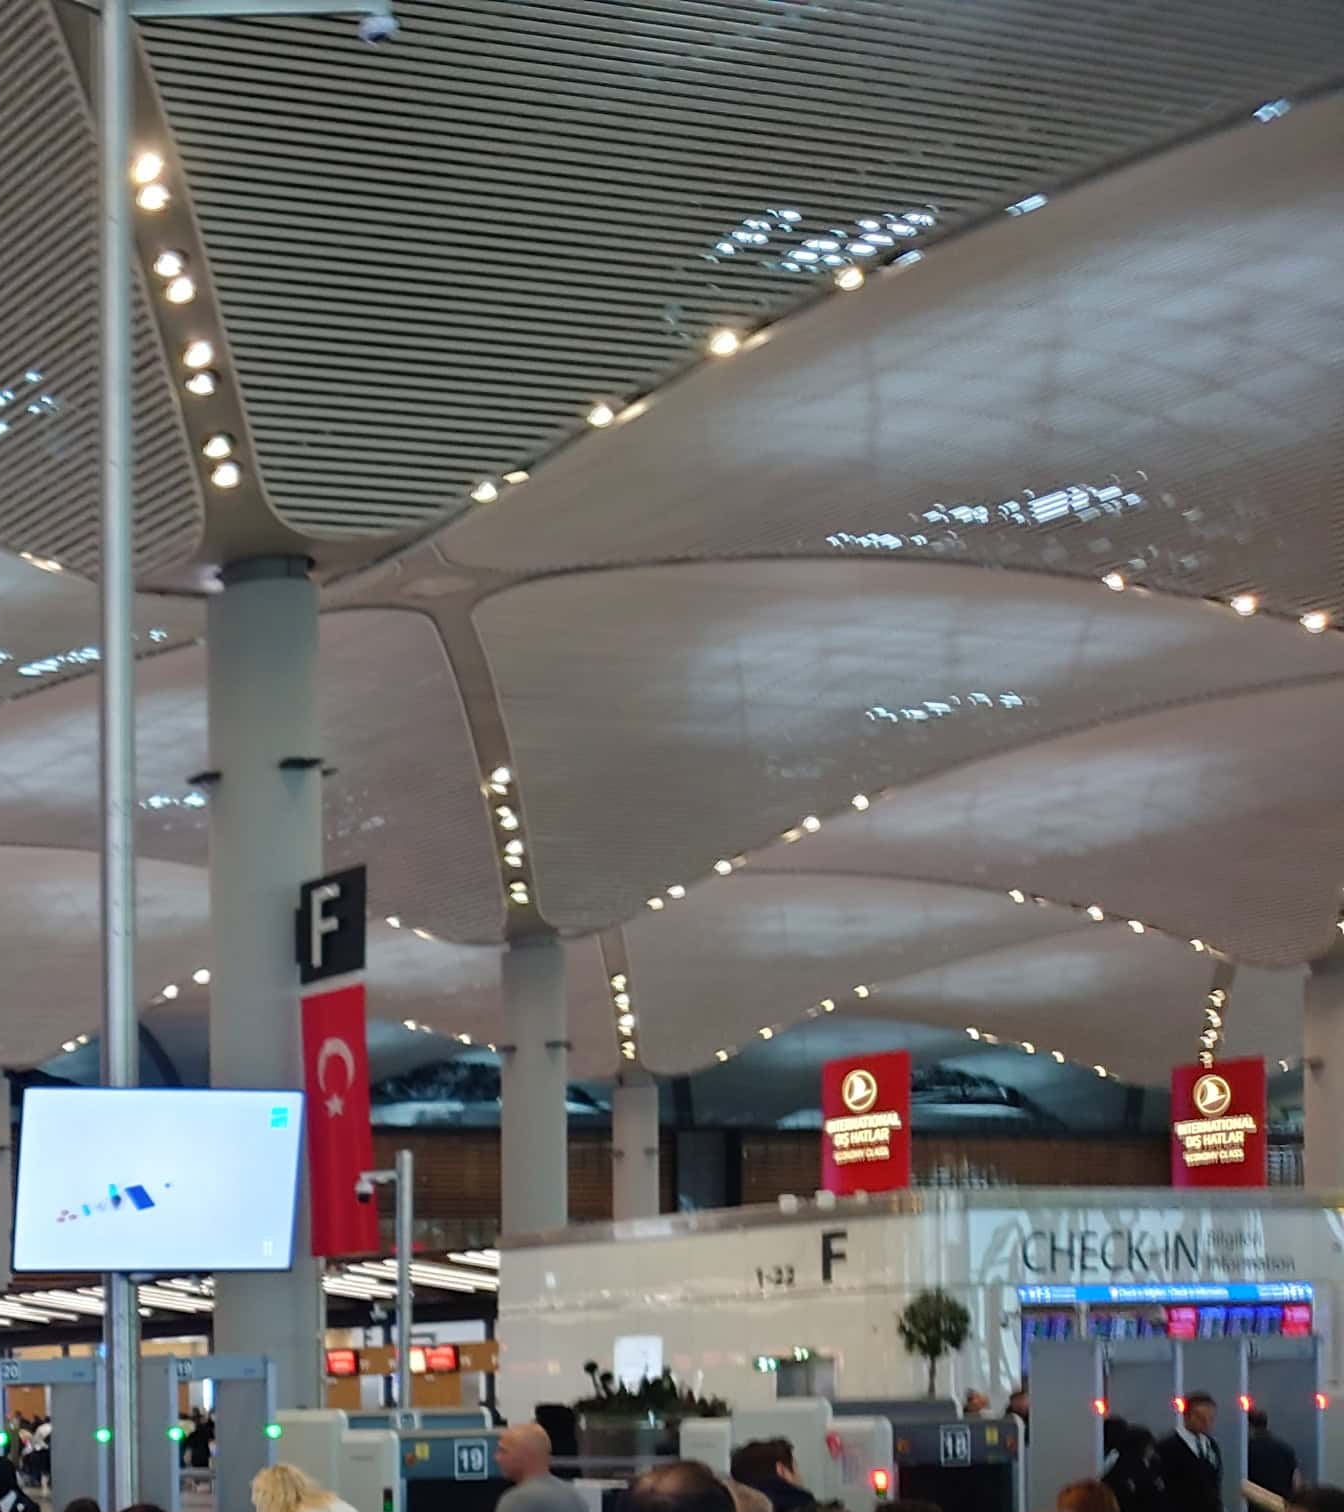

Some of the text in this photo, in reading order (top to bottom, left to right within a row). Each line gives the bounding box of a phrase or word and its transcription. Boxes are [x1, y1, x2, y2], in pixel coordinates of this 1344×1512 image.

[311, 882, 341, 969] F
[1175, 1115, 1256, 1138] INTERNATIONAL
[1202, 1131, 1244, 1147] HATLAR
[821, 1230, 849, 1283] F
[1021, 1229, 1200, 1273] CHECK-IN
[459, 1447, 484, 1472] 19
